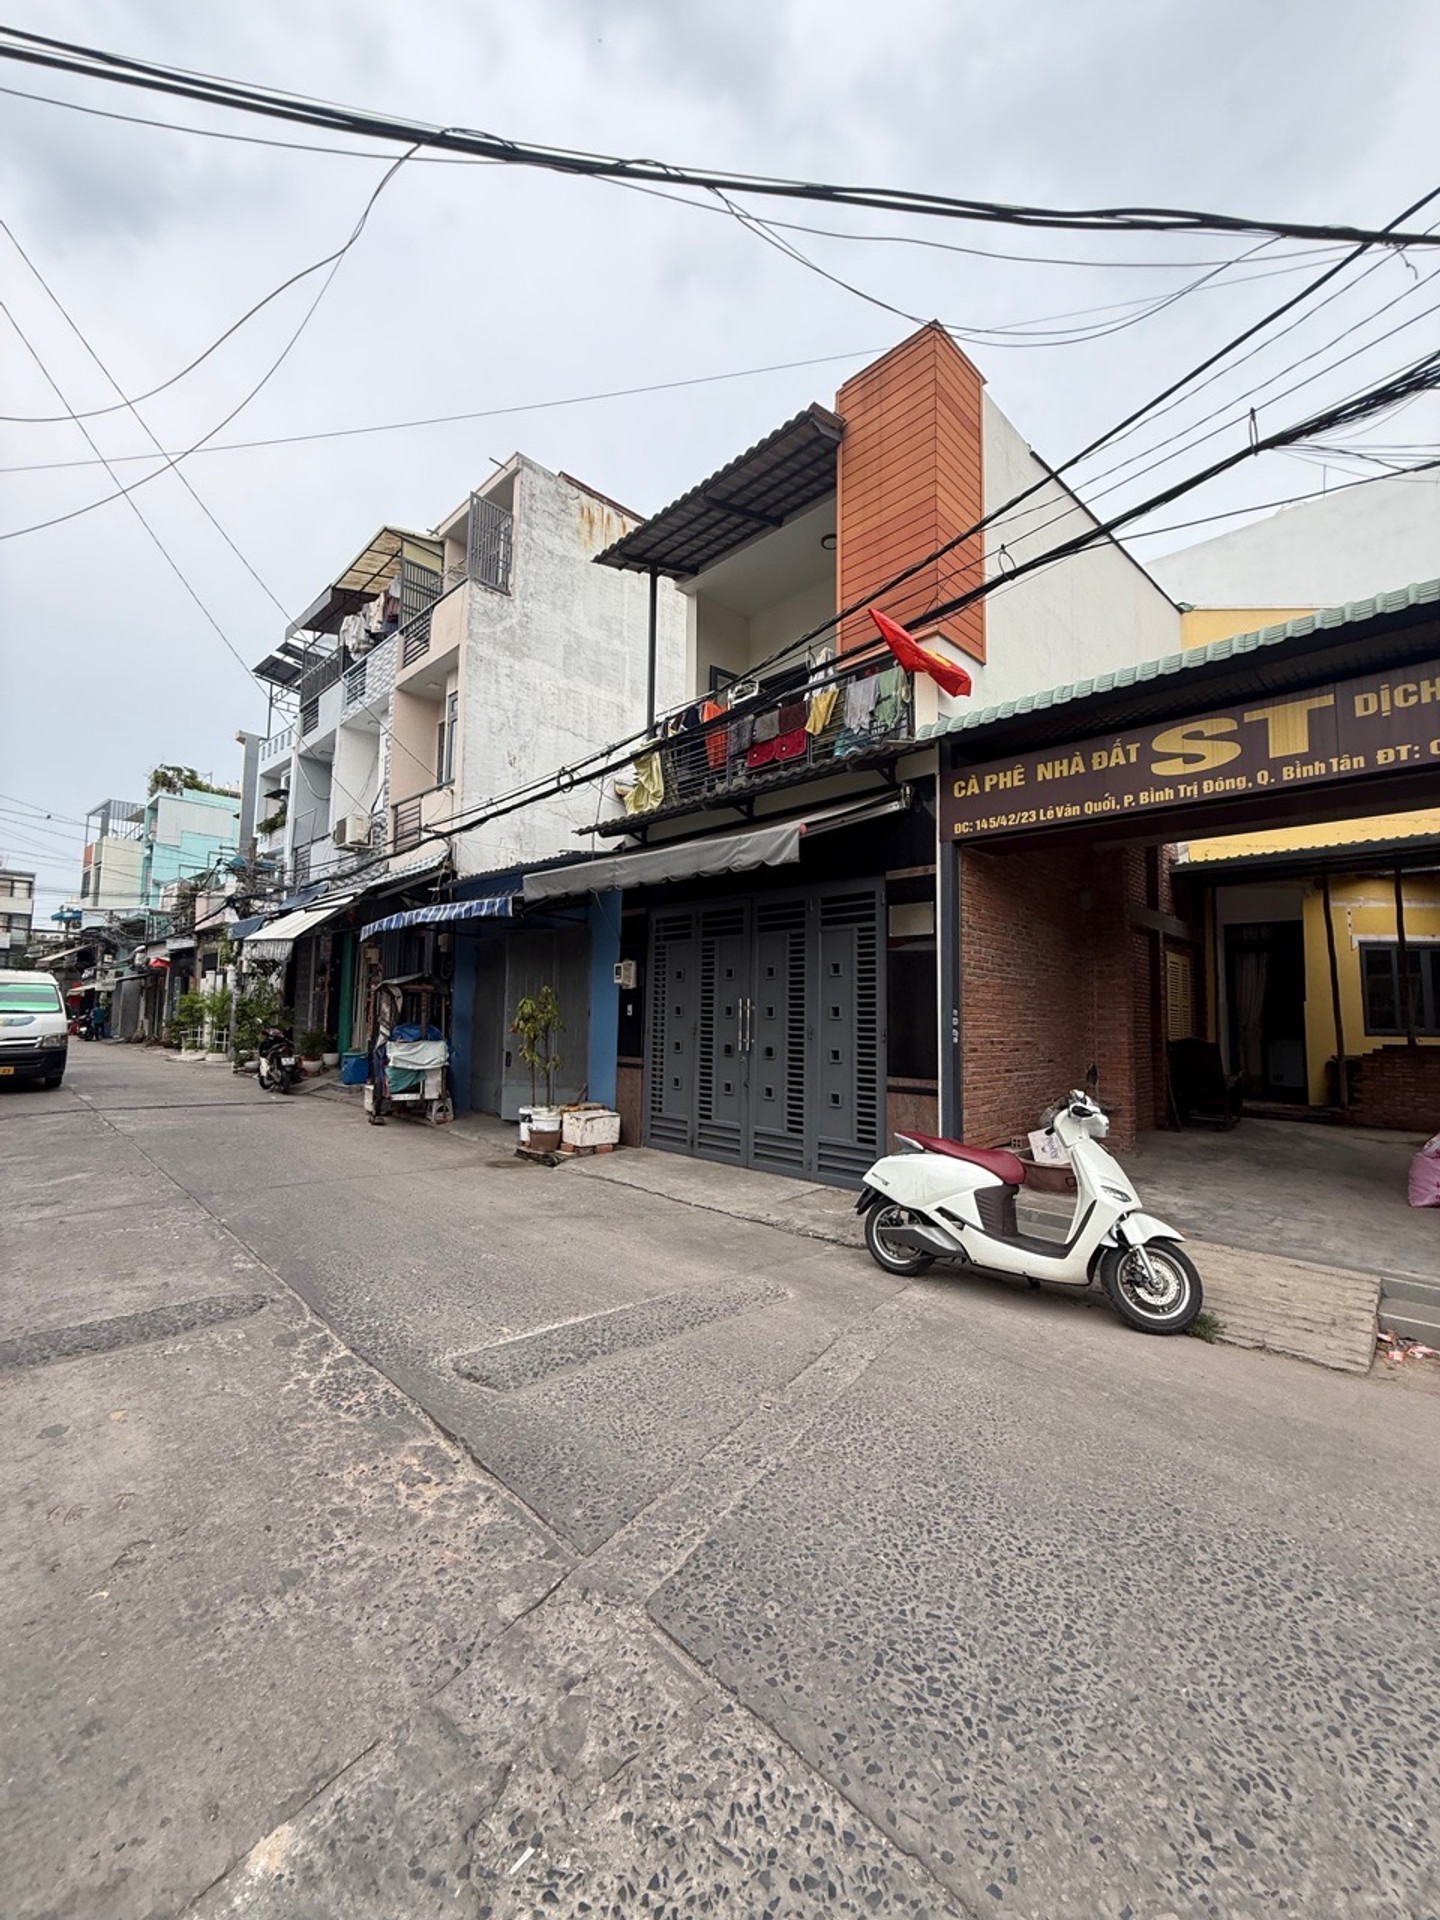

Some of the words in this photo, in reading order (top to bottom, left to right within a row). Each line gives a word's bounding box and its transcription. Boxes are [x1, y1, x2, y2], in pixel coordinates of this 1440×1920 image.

[953, 775, 980, 798] CÀ
[984, 764, 1026, 792] PHÊ
[1036, 752, 1086, 782] NHÀ
[1091, 738, 1141, 771] ĐẤT
[1151, 693, 1335, 776] ST
[974, 810, 1037, 832] 145/42/23
[1039, 806, 1055, 821] Lê
[1055, 803, 1080, 818] Văn
[1123, 795, 1136, 808] P.
[1139, 787, 1174, 804] Bình
[1178, 781, 1199, 799] Trị
[1202, 775, 1253, 794] Đông,
[1256, 769, 1276, 786] Q.
[1282, 760, 1326, 781] Bình
[1329, 754, 1366, 773] Tân
[1376, 744, 1421, 765] ĐT:
